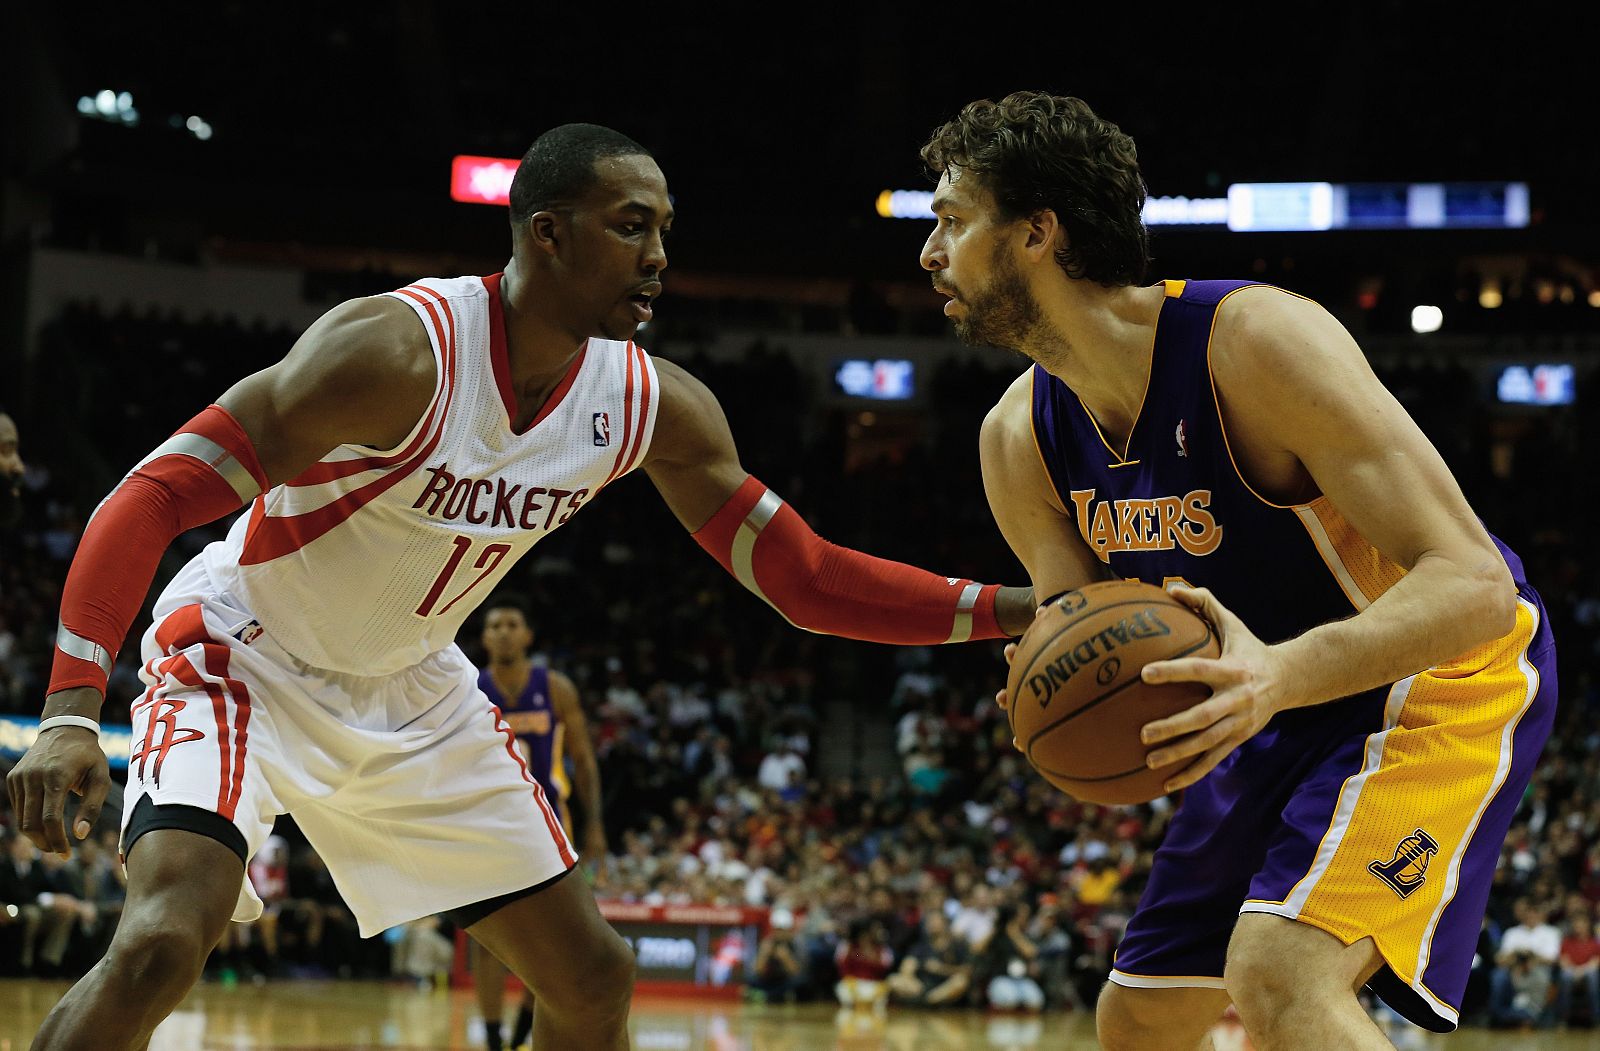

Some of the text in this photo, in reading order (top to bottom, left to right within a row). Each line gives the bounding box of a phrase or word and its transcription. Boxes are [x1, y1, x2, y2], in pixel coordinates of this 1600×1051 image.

[412, 462, 589, 530] ROCKETS
[1070, 488, 1223, 564] LAKERS
[1027, 607, 1171, 710] SPALDING
